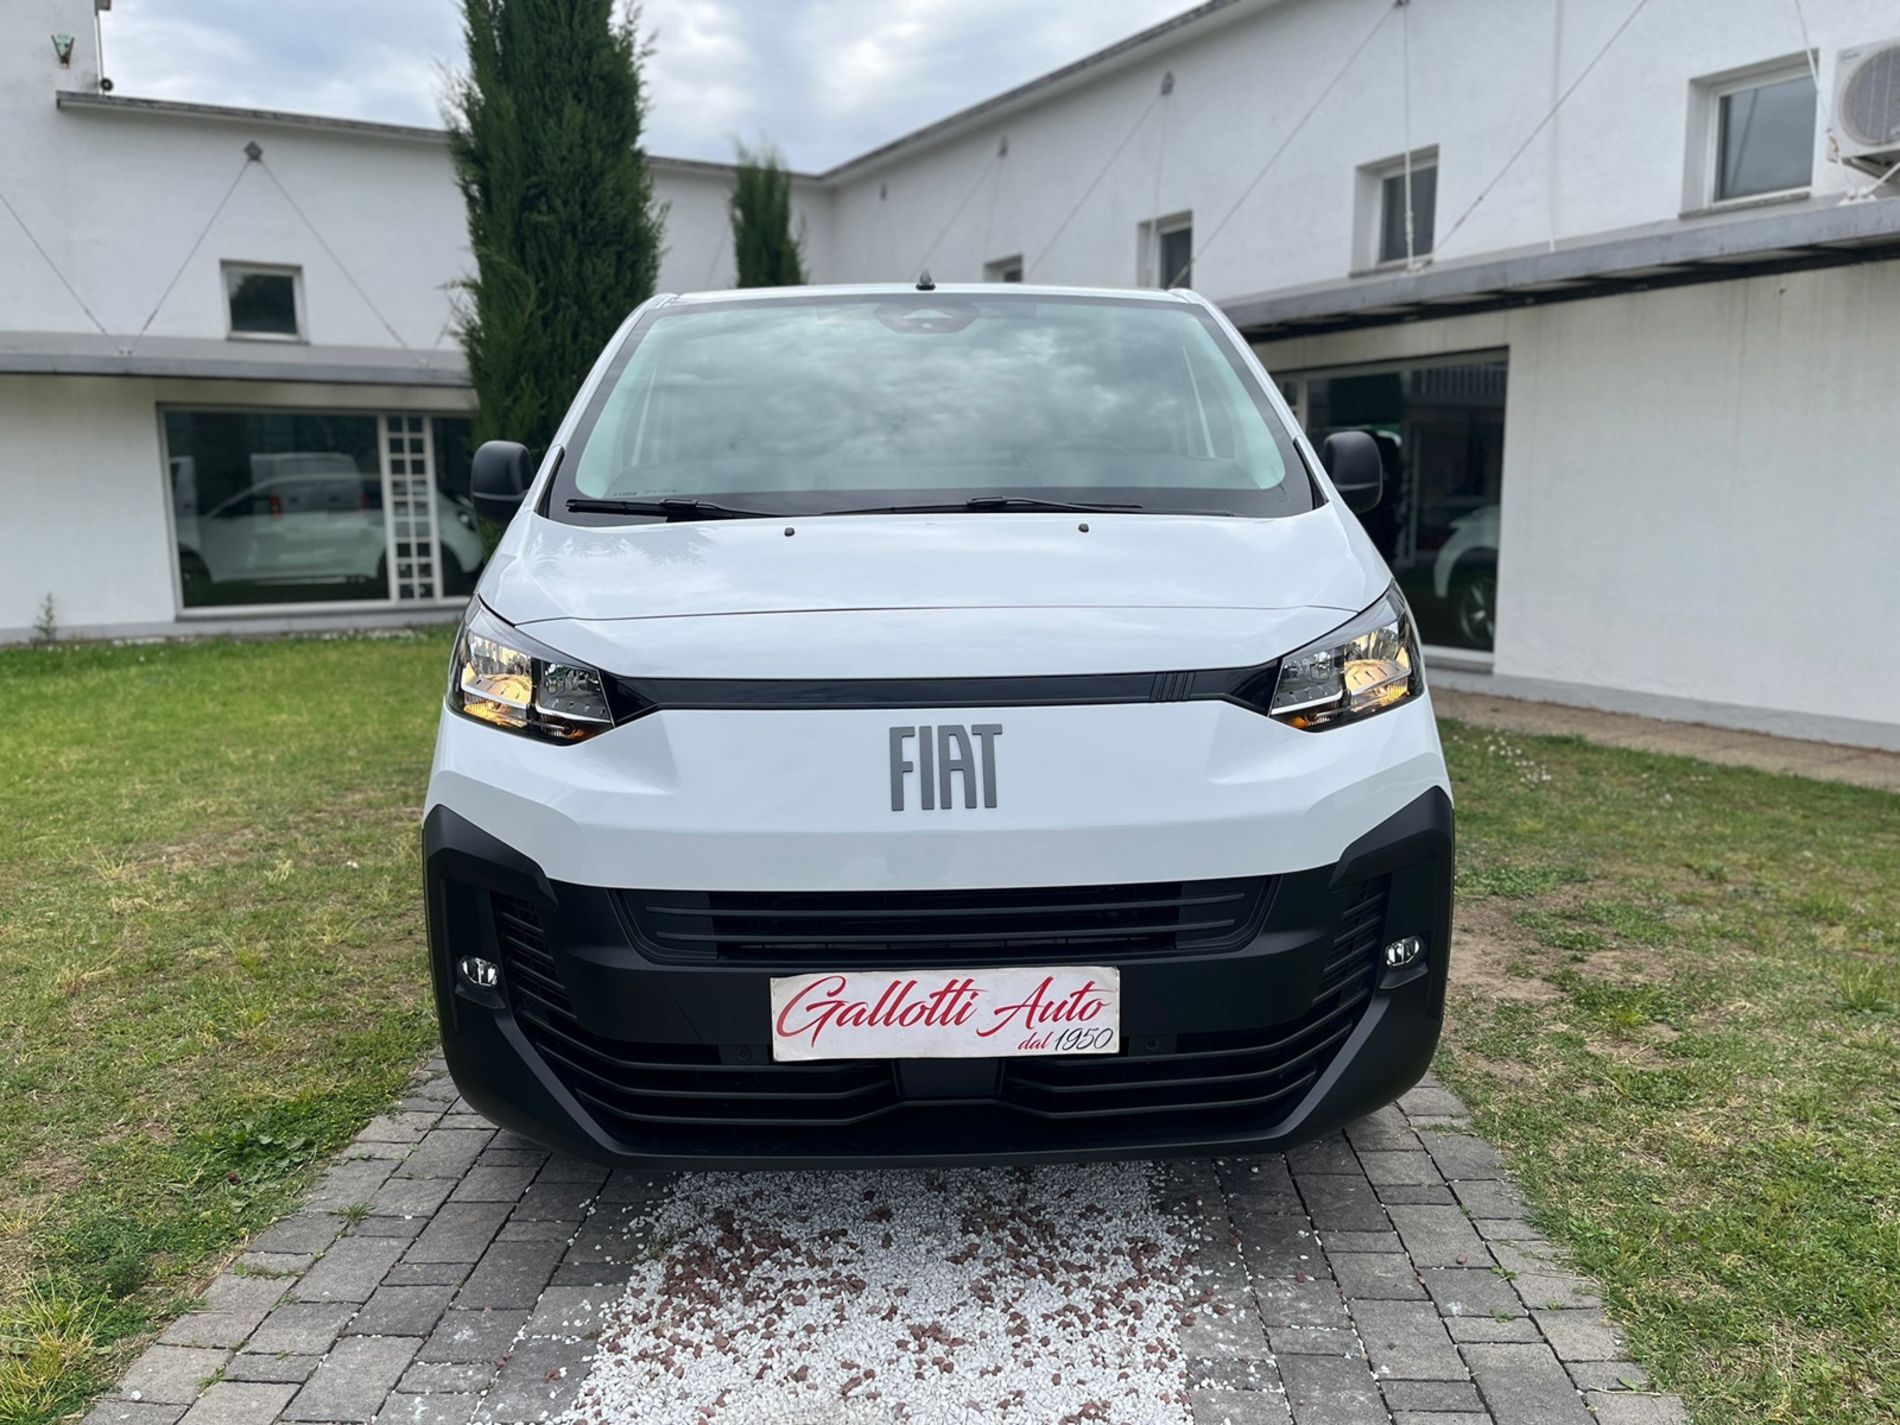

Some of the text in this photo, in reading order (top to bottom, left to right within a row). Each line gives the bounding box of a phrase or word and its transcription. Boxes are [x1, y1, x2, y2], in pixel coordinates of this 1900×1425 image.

[889, 724, 1003, 811] FIAT
[776, 976, 1114, 1048] Gallotti Auto
[1018, 1027, 1114, 1051] dal 1950
